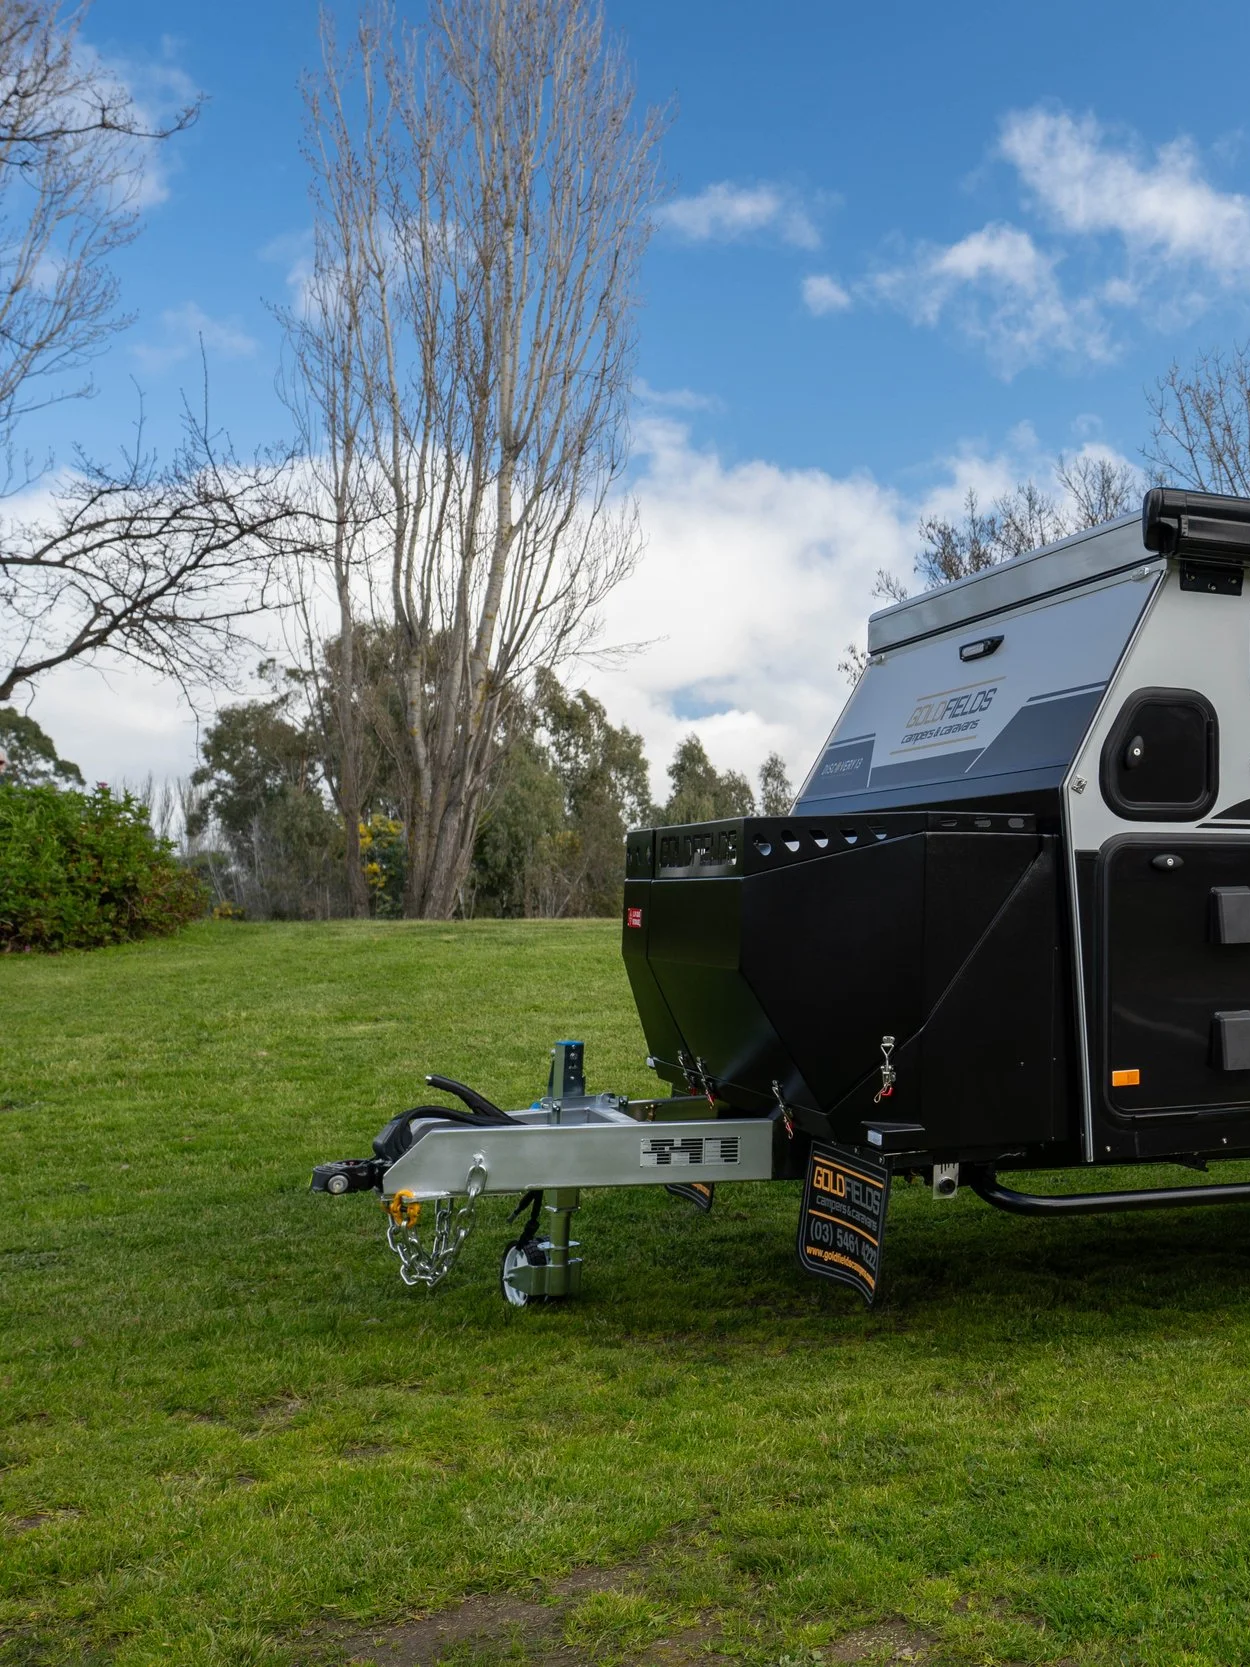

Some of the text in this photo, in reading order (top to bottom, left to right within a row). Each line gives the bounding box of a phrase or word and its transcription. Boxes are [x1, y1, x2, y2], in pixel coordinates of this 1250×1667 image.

[905, 688, 997, 728] GOLDFIELDS
[901, 729, 936, 744] campers
[939, 719, 981, 736] caravans
[813, 1165, 881, 1216] GOLDFIELDS
[816, 1194, 847, 1215] campers
[851, 1208, 878, 1232] caravans
[810, 1217, 834, 1247] (03)
[836, 1227, 859, 1256] 5461
